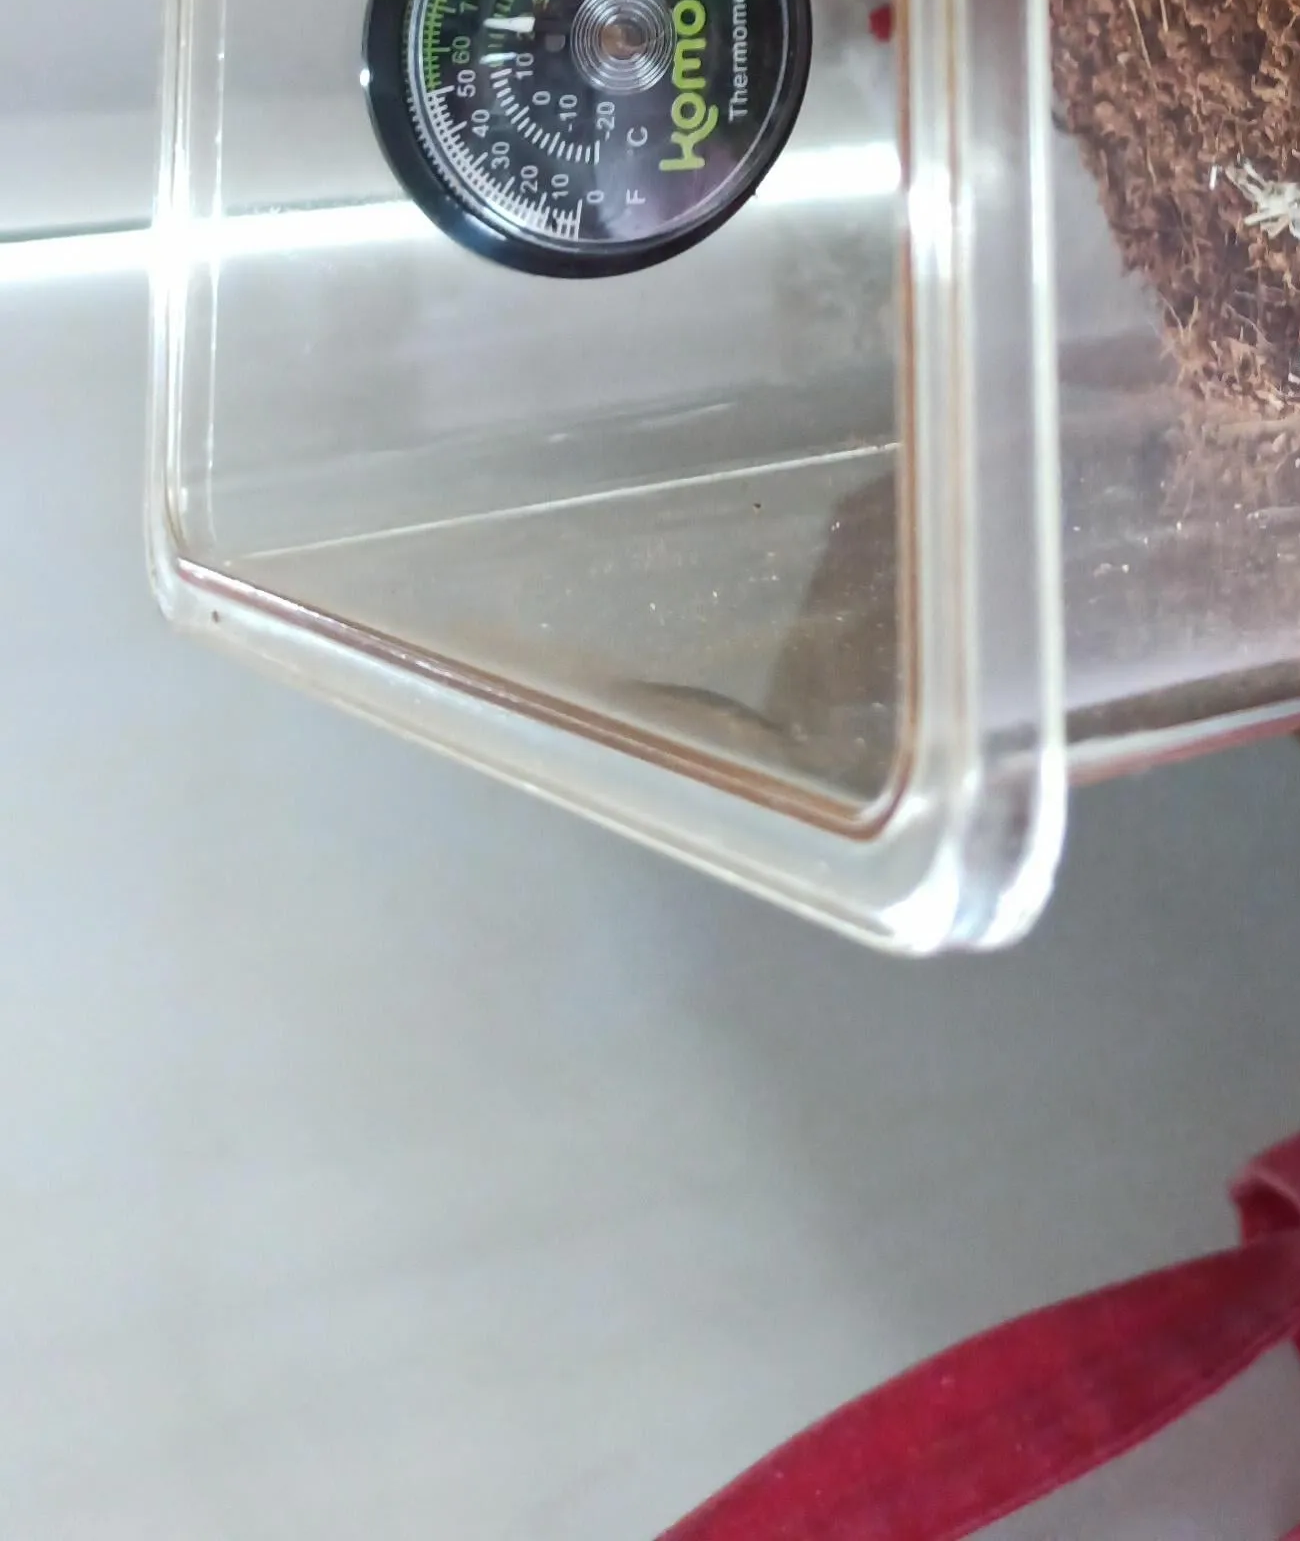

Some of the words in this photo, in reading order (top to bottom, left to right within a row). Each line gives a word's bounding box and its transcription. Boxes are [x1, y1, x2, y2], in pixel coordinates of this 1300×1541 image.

[452, 36, 471, 64] 60
[515, 53, 534, 79] 10
[457, 70, 475, 98] 50
[532, 90, 550, 106] 0
[472, 109, 490, 138] 40
[559, 94, 577, 132] -10
[596, 101, 614, 141] -20
[491, 141, 510, 170] 30
[520, 165, 539, 194] 20
[551, 174, 569, 200] 10
[586, 190, 604, 204] 0
